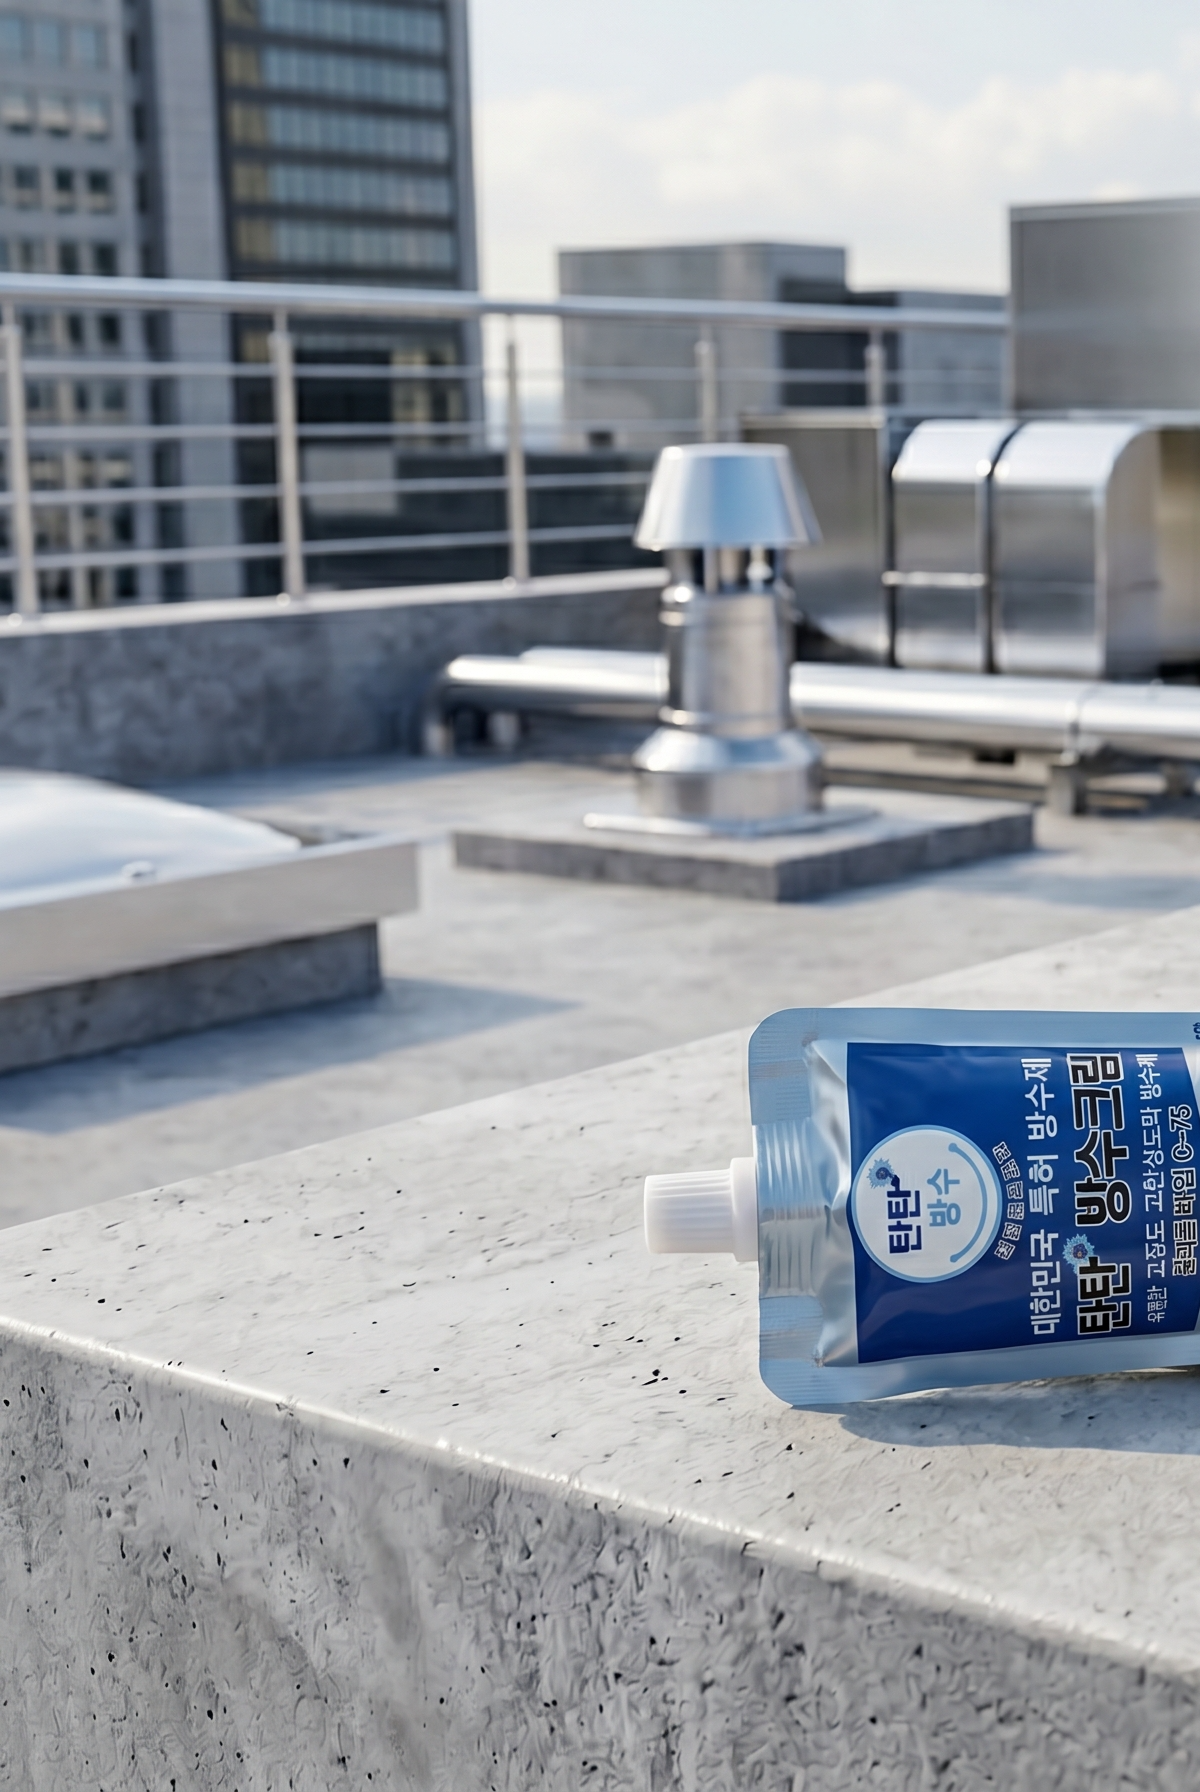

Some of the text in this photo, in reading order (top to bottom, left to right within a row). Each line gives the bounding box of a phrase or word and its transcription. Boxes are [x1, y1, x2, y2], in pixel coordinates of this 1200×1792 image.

[886, 1178, 922, 1254] 탄탄
[927, 1168, 961, 1227] 방수
[1021, 1058, 1061, 1335] 대한민국 특허 방수제
[1066, 1052, 1132, 1335] 탄탄 방수크림
